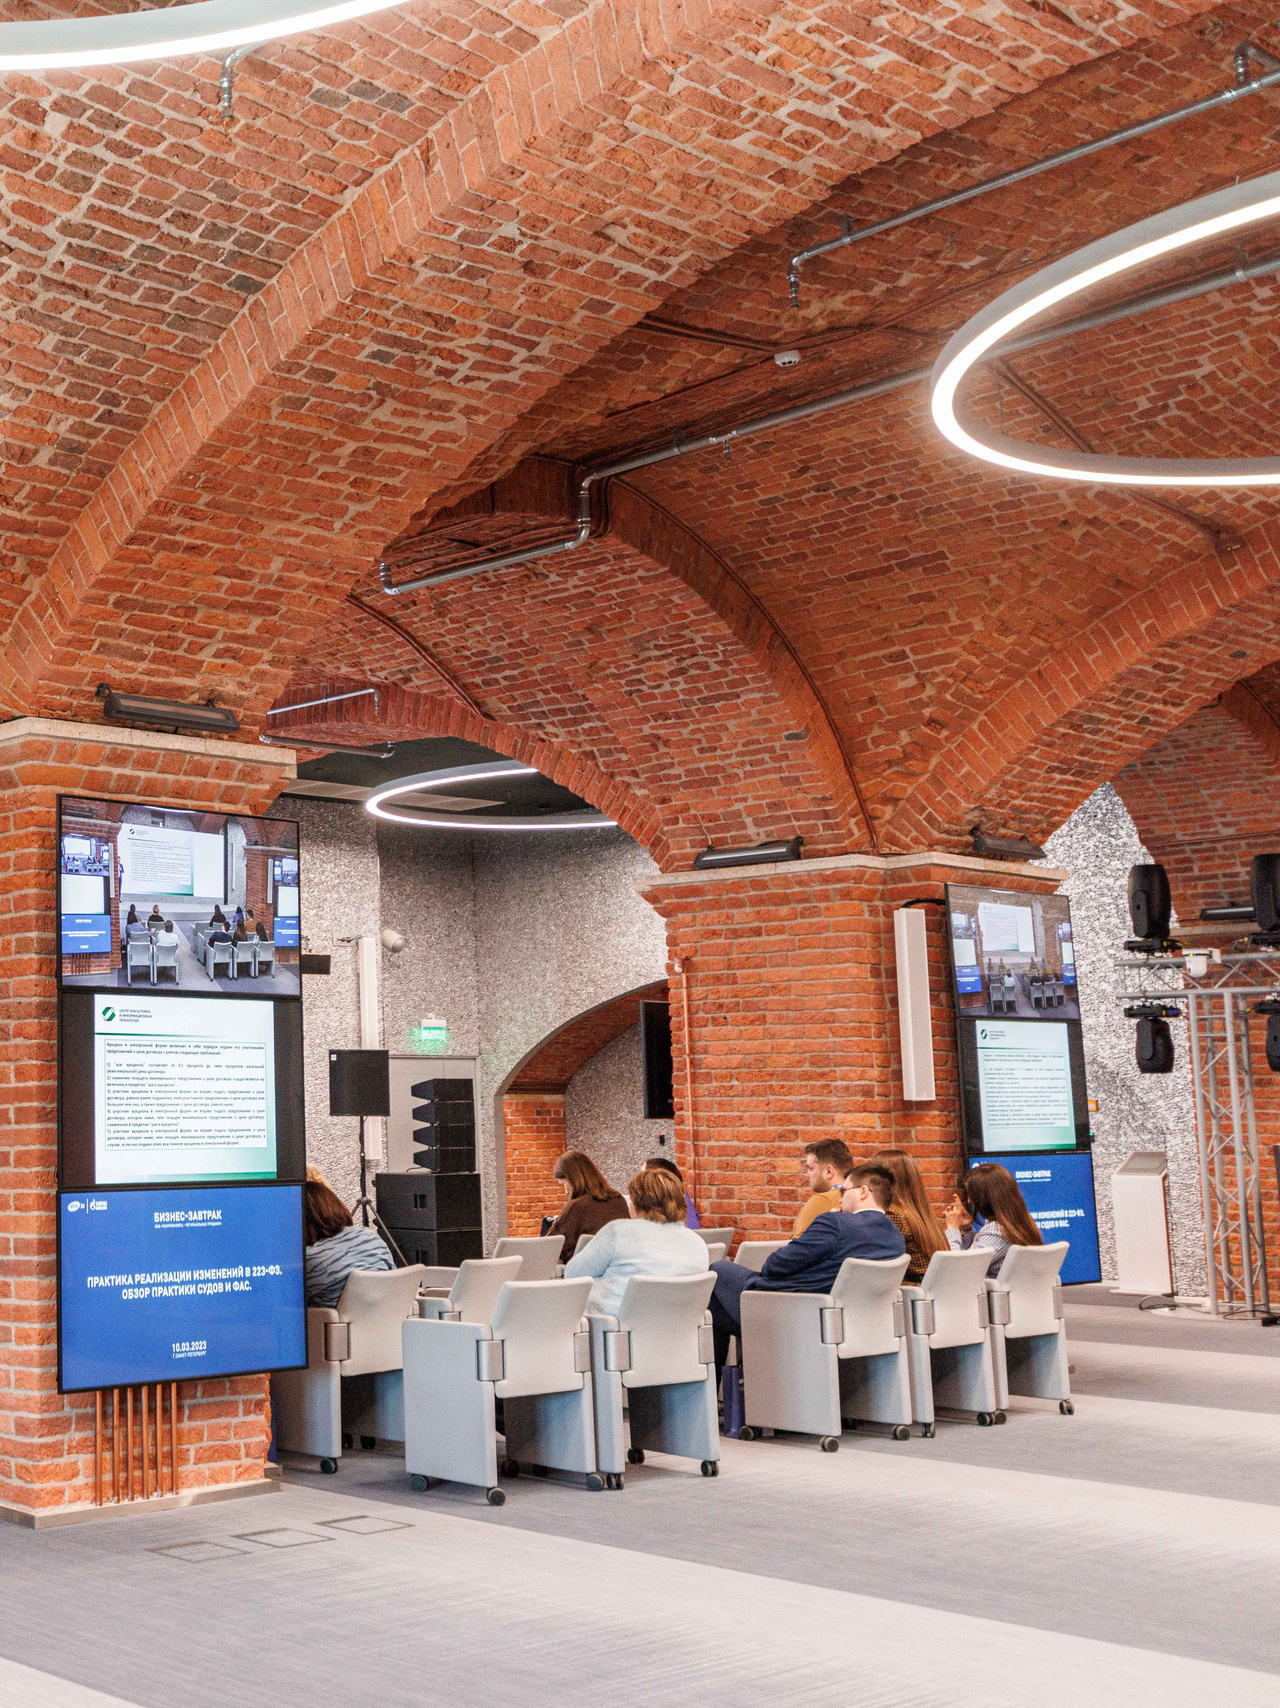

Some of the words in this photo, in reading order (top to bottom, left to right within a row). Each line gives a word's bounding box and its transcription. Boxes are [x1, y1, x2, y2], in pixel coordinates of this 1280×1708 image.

[154, 1210, 222, 1222] БИЗНЕС-ЗАВТРАК
[87, 1275, 133, 1288] ПРАКТИКА
[135, 1271, 192, 1285] РЕАЛИЗАЦИИ
[193, 1266, 244, 1281] ИЗМЕНЕНИЙ
[245, 1267, 251, 1277] В
[252, 1265, 282, 1277] 223-ФЗ.
[122, 1288, 150, 1300] ОБЗОР
[152, 1284, 196, 1298] ПРАКТИКИ
[197, 1283, 224, 1295] СУДОВ
[225, 1282, 231, 1292] И
[233, 1281, 252, 1291] ФАС.
[172, 1340, 207, 1352] 10.03.2023
